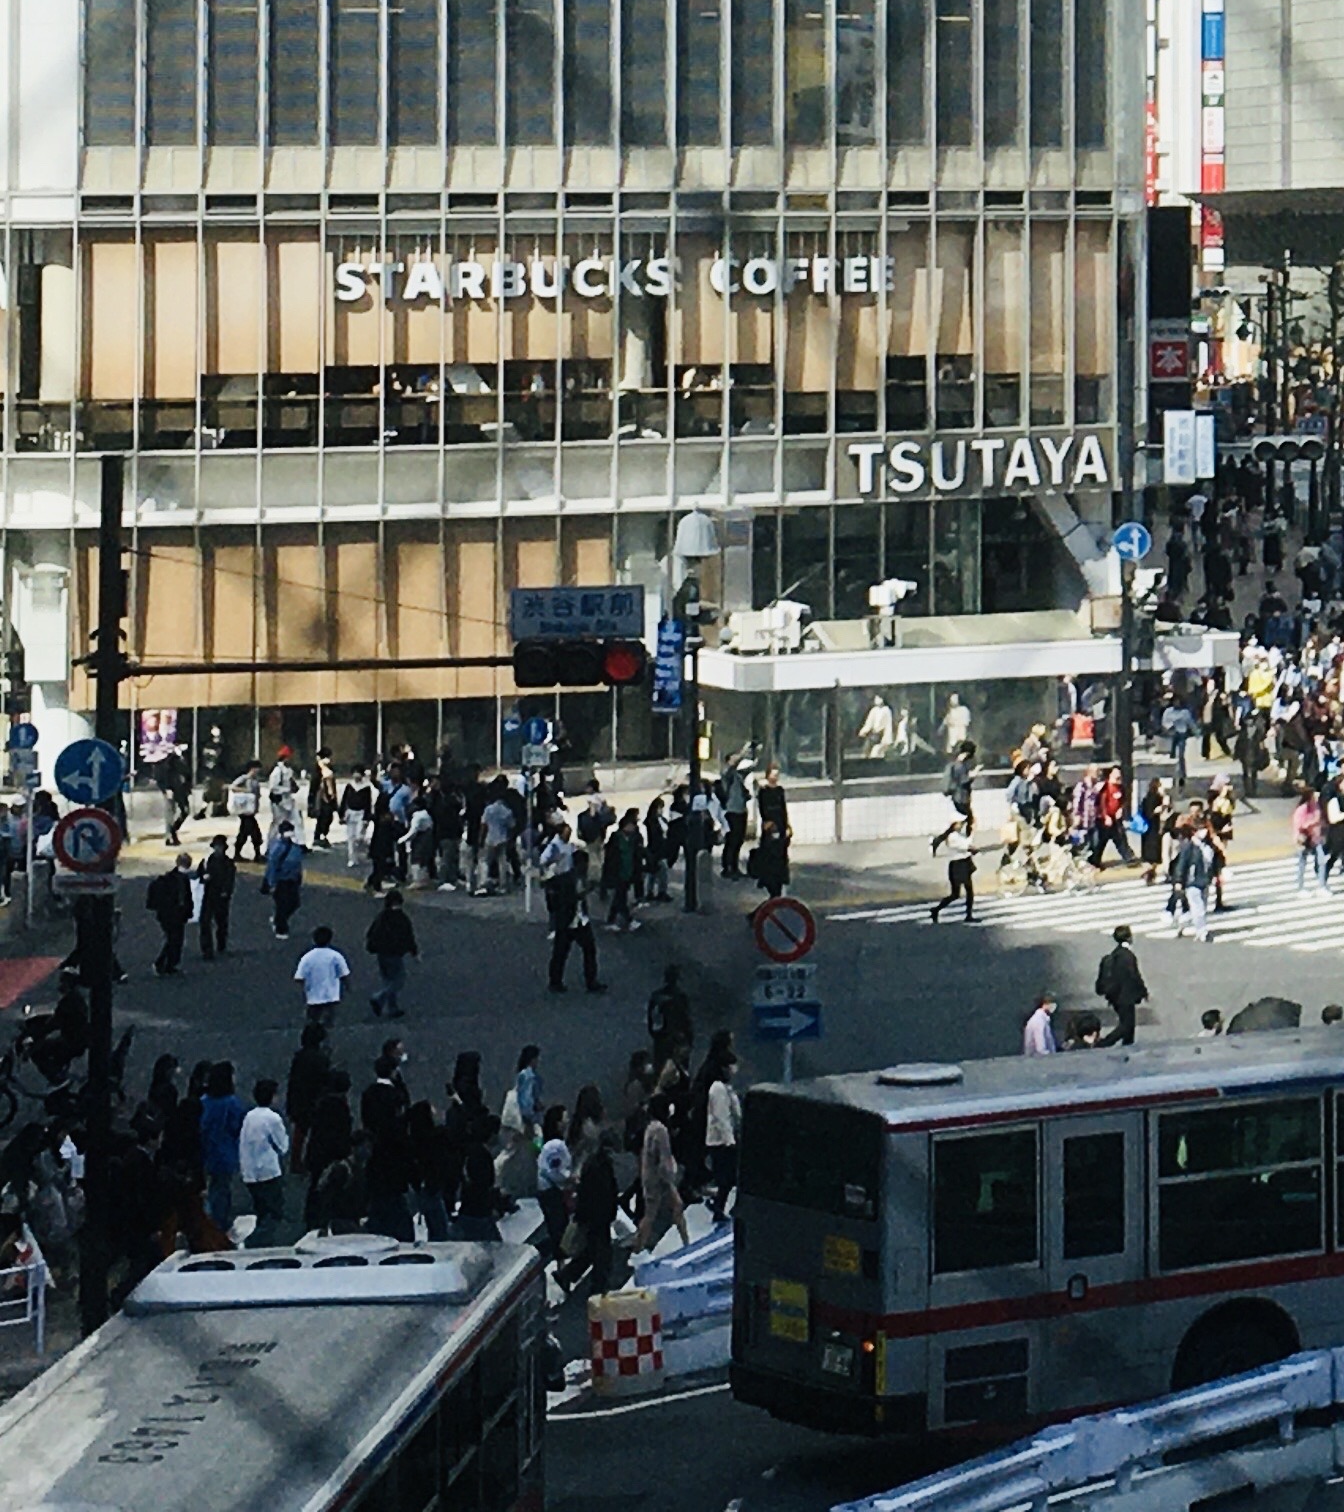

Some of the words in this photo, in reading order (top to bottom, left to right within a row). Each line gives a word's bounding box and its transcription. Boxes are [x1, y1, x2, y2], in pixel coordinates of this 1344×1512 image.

[334, 256, 682, 302] STARBUCKS
[709, 254, 896, 298] COFFEE
[848, 435, 1108, 494] TSUTAYA
